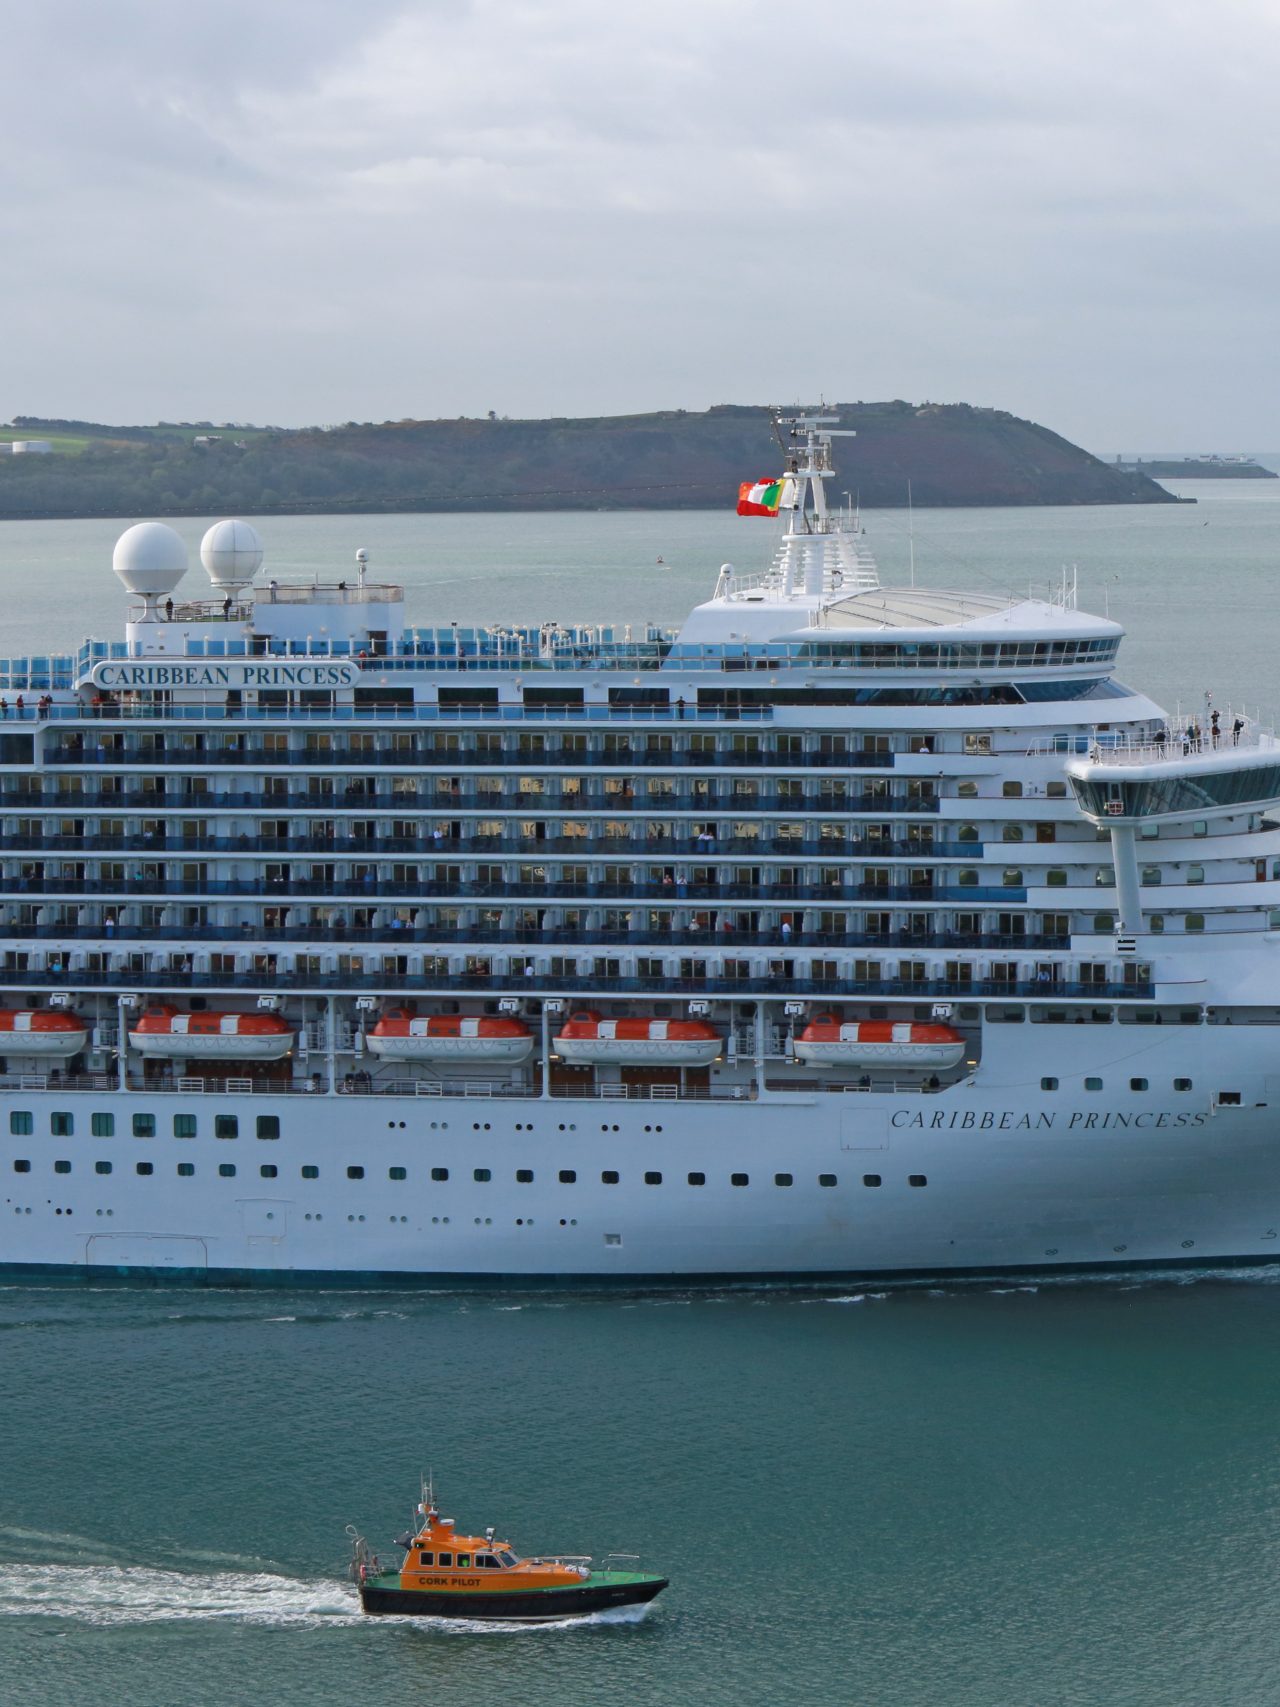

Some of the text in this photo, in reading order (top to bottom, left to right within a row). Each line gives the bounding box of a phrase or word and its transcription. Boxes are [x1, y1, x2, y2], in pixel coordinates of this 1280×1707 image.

[100, 667, 351, 685] CARIBBEAN PRINCESS
[891, 1110, 1208, 1129] CARIBBEAN PRINCESS
[418, 1577, 481, 1586] CORK PILOT
